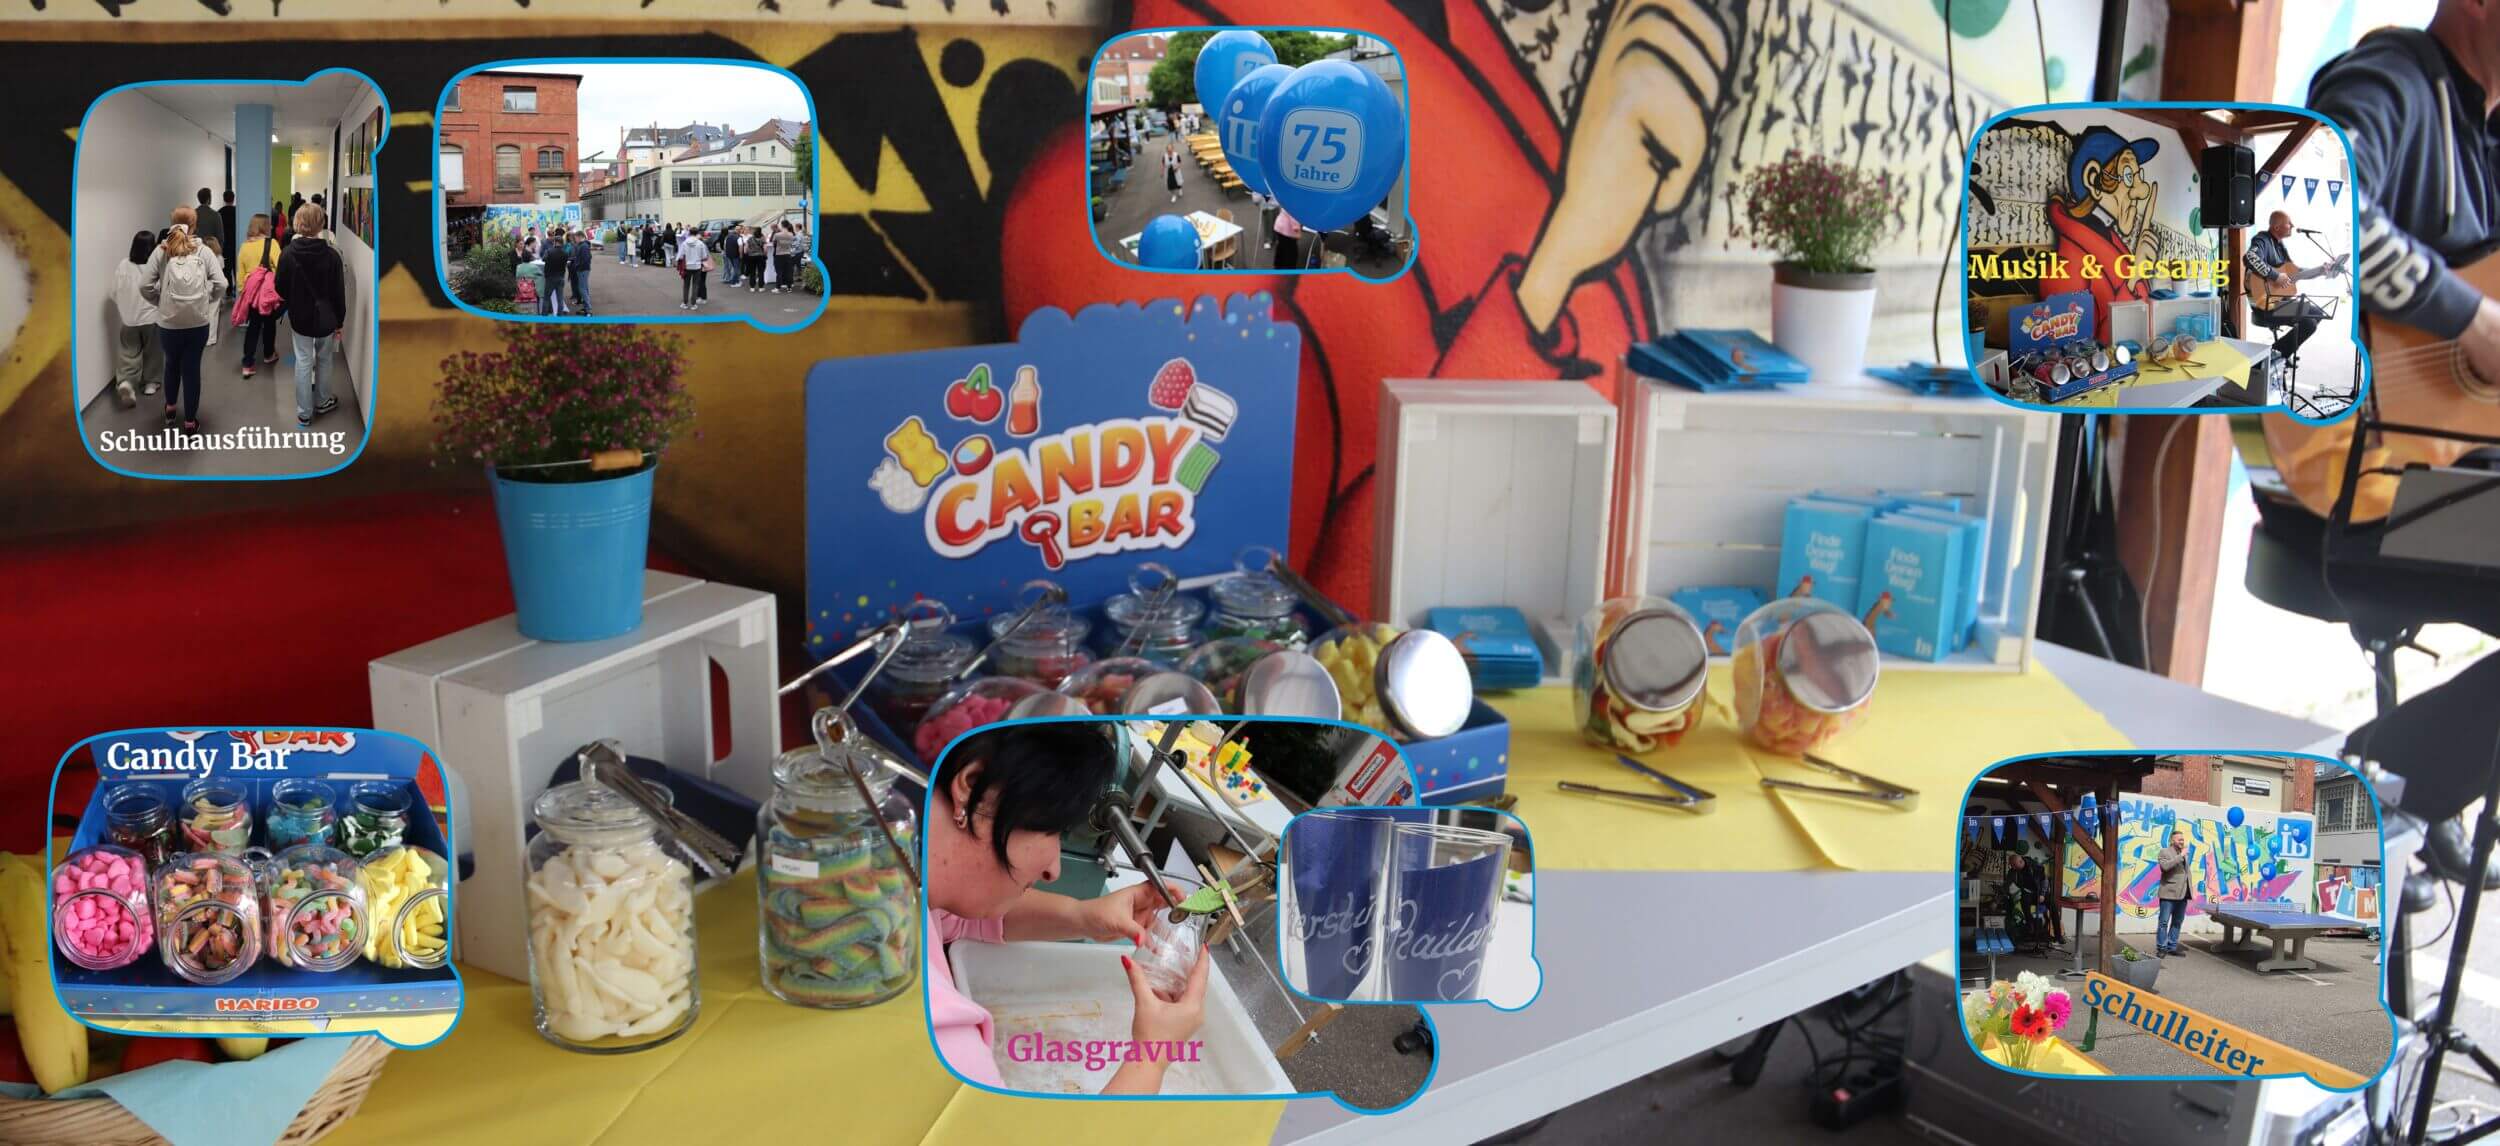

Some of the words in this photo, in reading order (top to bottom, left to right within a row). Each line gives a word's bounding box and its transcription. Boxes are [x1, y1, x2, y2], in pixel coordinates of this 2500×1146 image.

[1294, 123, 1347, 165] 75
[1294, 164, 1340, 183] Jahre
[2032, 312, 2077, 339] CANDY
[935, 421, 1196, 545] CANDY
[1068, 490, 1184, 547] BAR
[216, 998, 318, 1011] HARIBO
